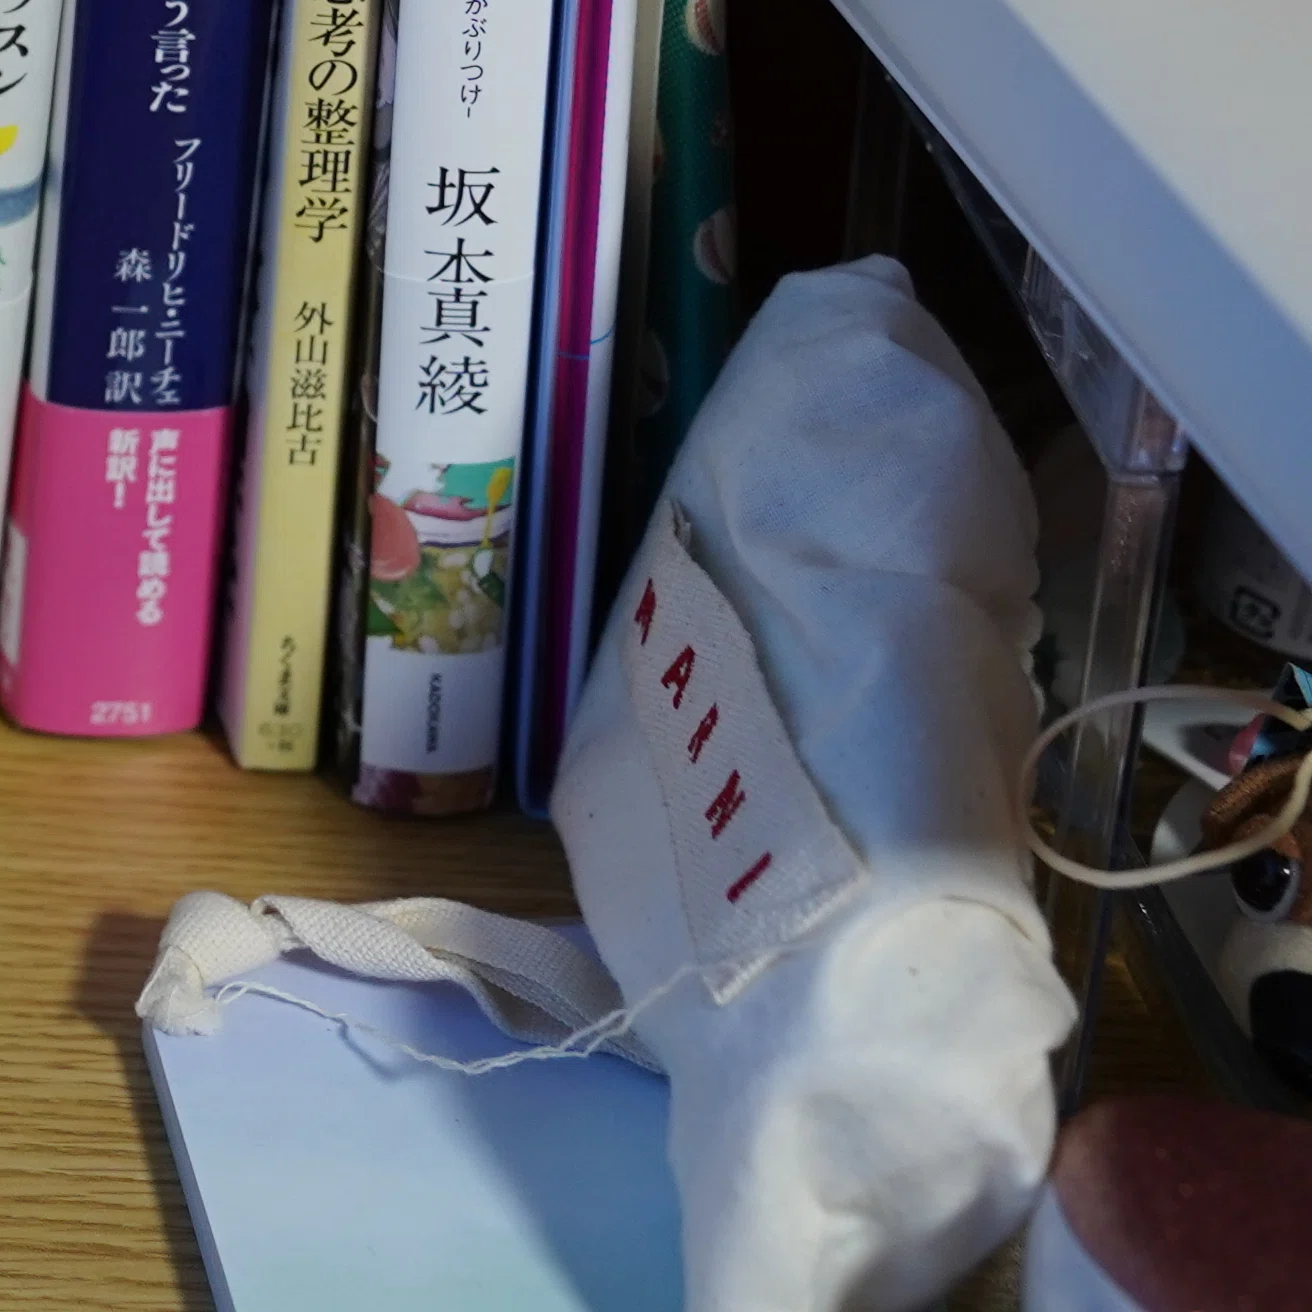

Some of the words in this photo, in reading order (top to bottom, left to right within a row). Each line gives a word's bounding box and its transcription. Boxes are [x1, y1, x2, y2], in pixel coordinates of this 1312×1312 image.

[415, 165, 502, 417] 坂本真綾
[285, 299, 335, 467] 外山滋比古
[135, 427, 182, 626] 声に出して読める
[89, 701, 154, 726] 2751
